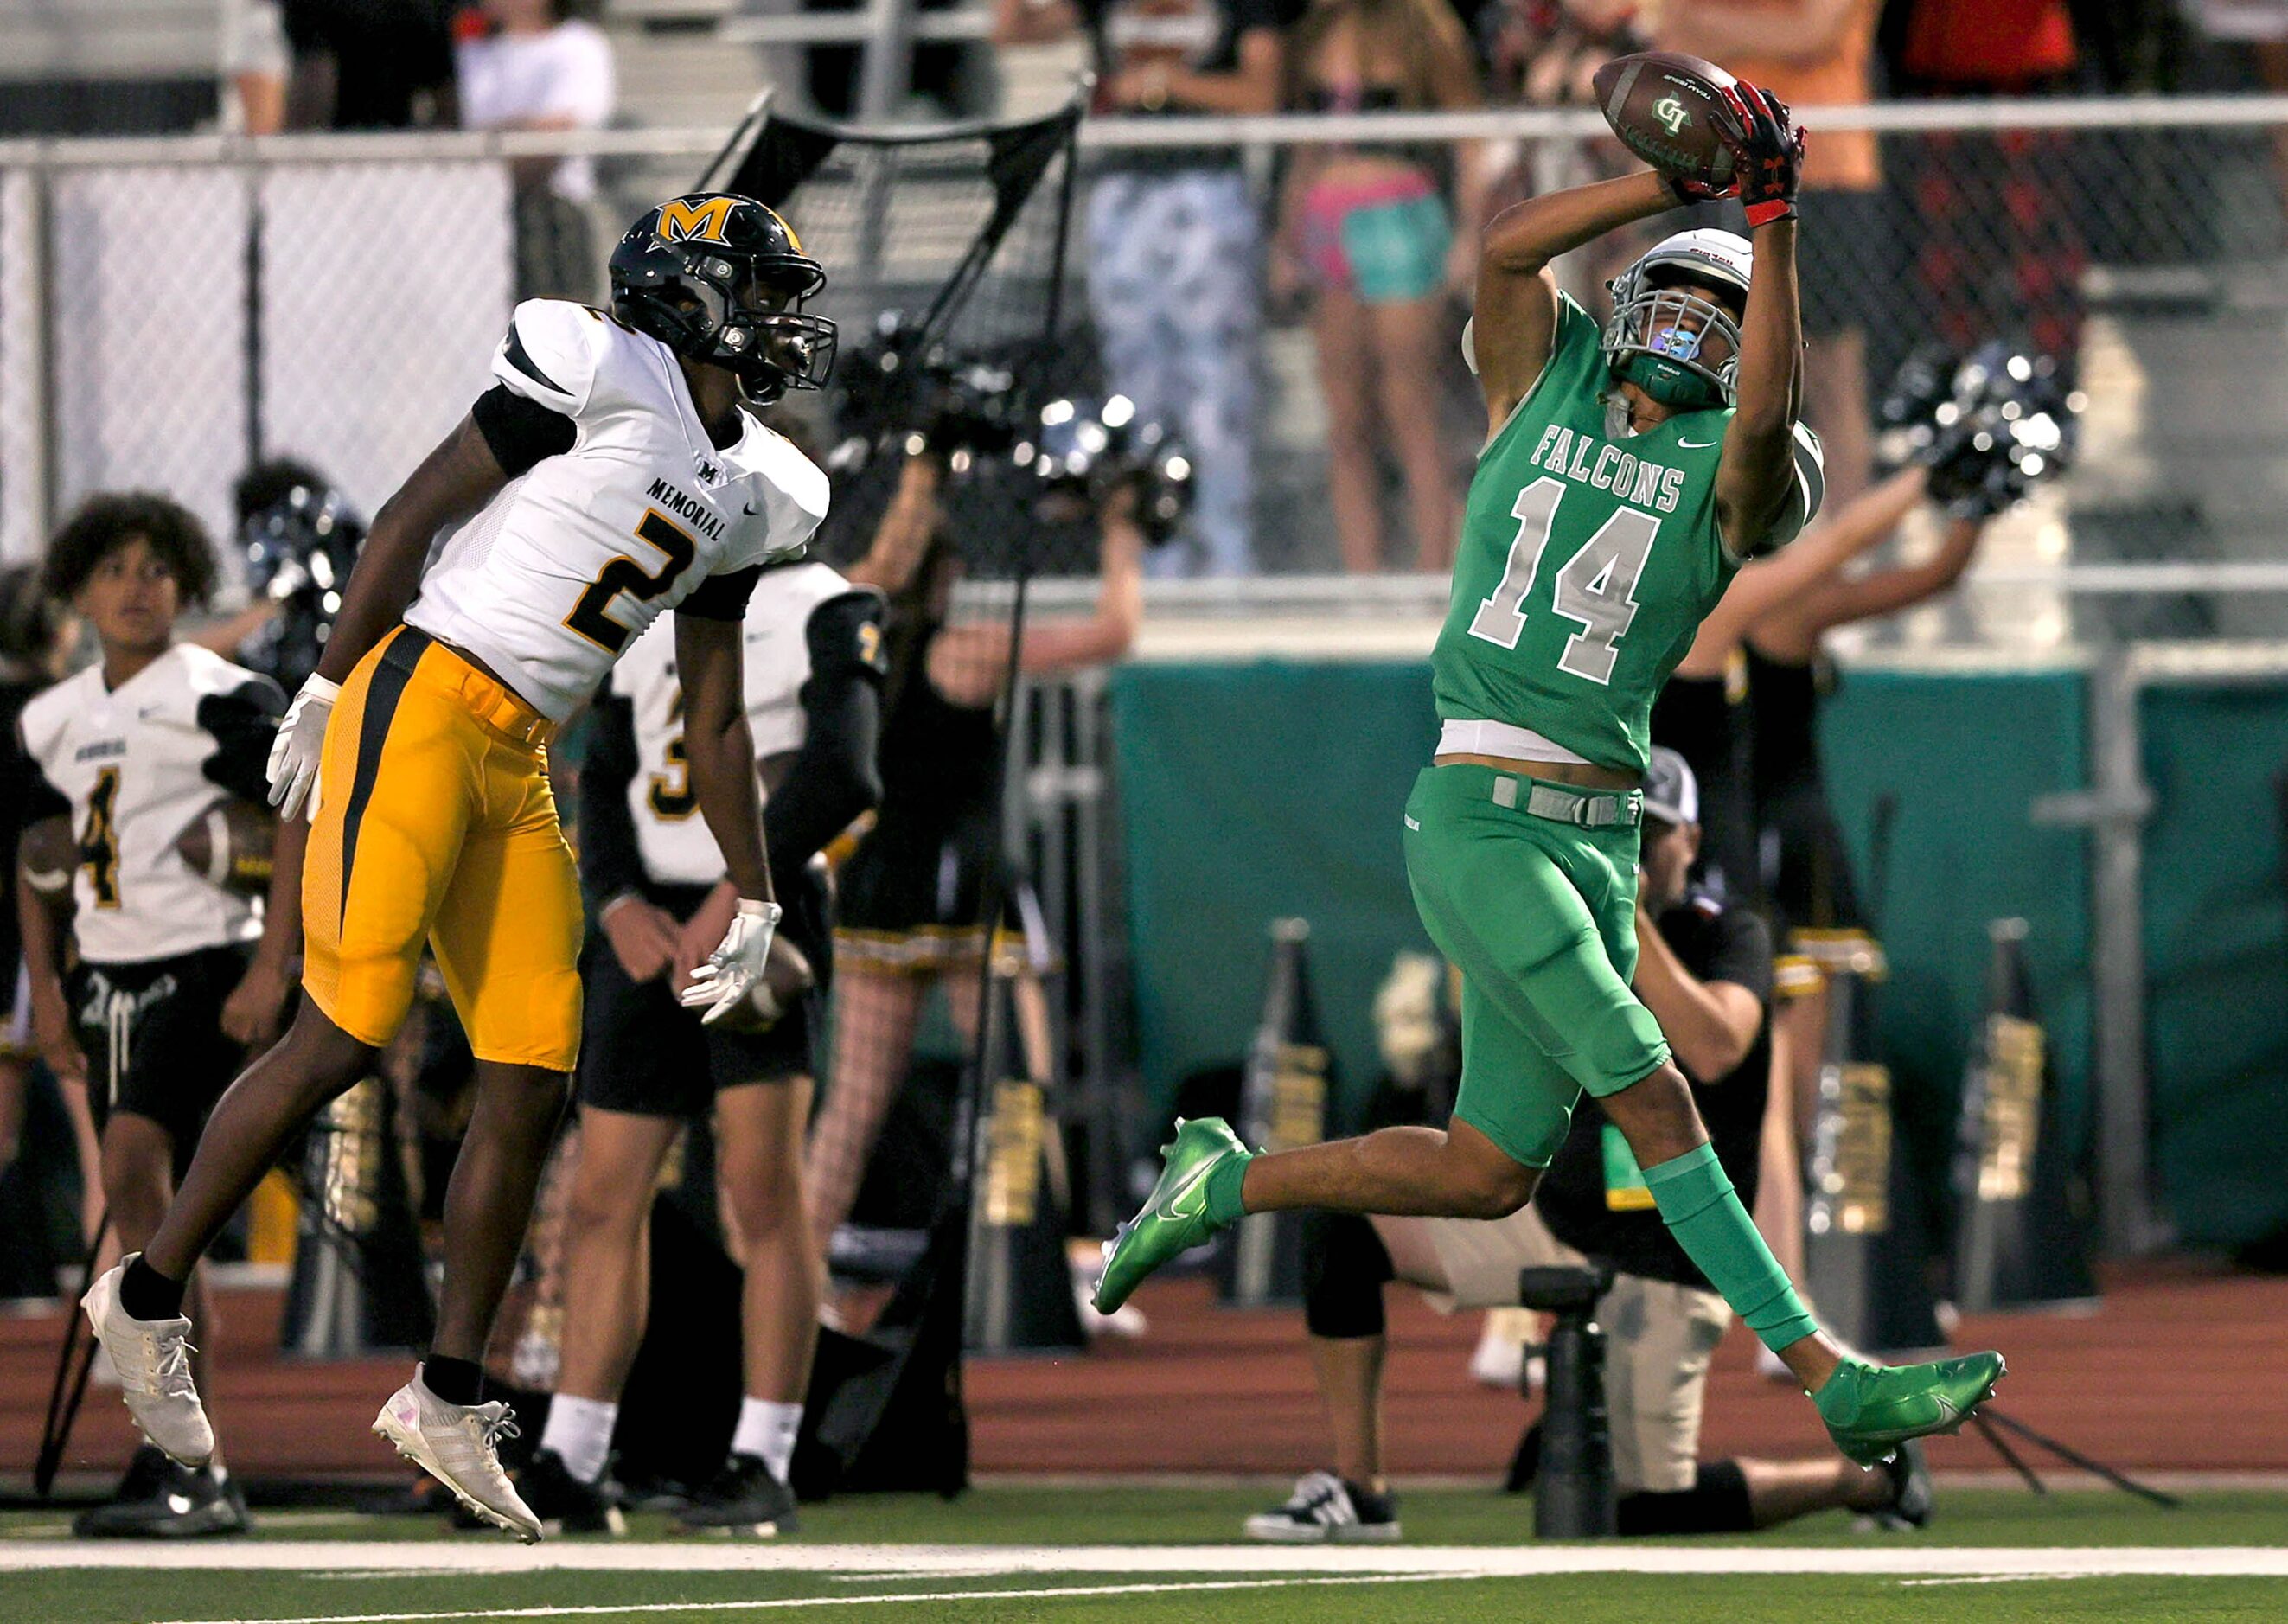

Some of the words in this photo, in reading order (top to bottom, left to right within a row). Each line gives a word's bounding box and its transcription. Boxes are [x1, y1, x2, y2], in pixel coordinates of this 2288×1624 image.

[645, 196, 751, 253] M
[698, 461, 718, 484] M
[1530, 424, 1685, 513] FALCONS
[646, 477, 725, 542] MEMORIAL
[561, 507, 698, 657] 2
[1467, 476, 1662, 686] 14
